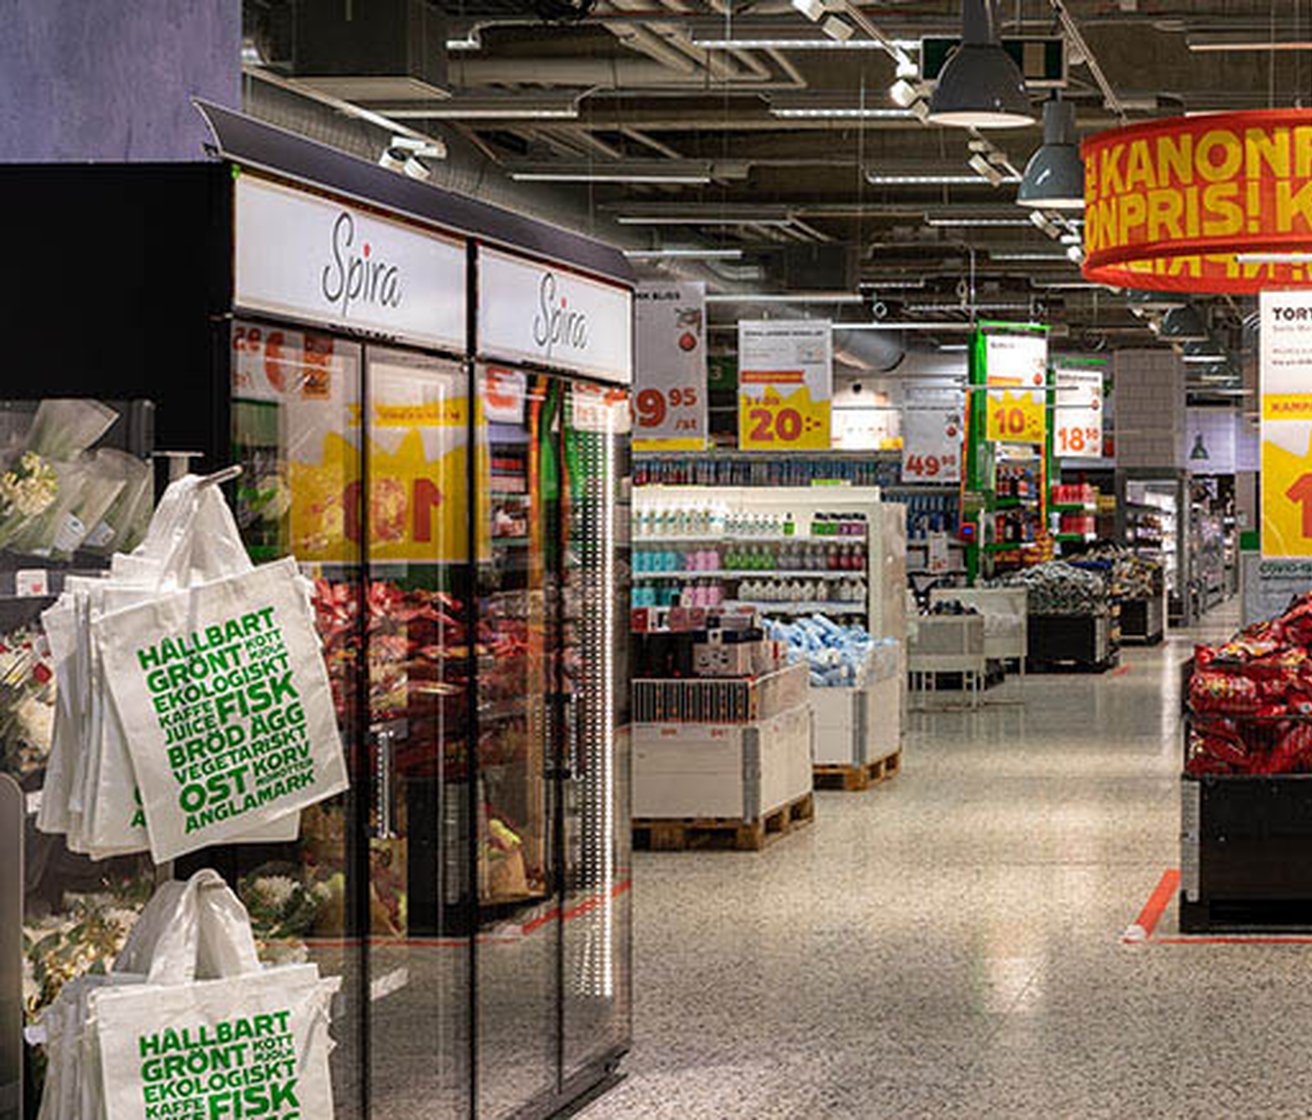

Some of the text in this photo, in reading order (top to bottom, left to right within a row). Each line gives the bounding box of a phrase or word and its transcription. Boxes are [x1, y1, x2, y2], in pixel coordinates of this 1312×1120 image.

[321, 211, 402, 317] Spira
[532, 272, 588, 359] Spira
[630, 388, 697, 428] 9 95
[749, 408, 821, 442] 20:-
[994, 408, 1038, 435] 10:-
[1058, 426, 1086, 452] 18
[905, 453, 940, 477] 49
[136, 606, 275, 670] HÅLLBART
[146, 643, 242, 693] GRÖNT
[152, 652, 289, 714] EKOLOGISKT
[158, 700, 214, 729] KAFFE
[215, 670, 299, 726] FISK
[165, 714, 218, 745] JUICE
[167, 702, 304, 769] BRÖD ÄGG
[174, 723, 308, 785] VEGETARISKT
[252, 741, 311, 777] KORV
[179, 765, 249, 813] OST
[138, 1010, 291, 1058] HÅLLBART
[140, 1042, 248, 1083] GRÖNT
[142, 1058, 297, 1104] EKOLOGISKT
[207, 1078, 300, 1120] FISK
